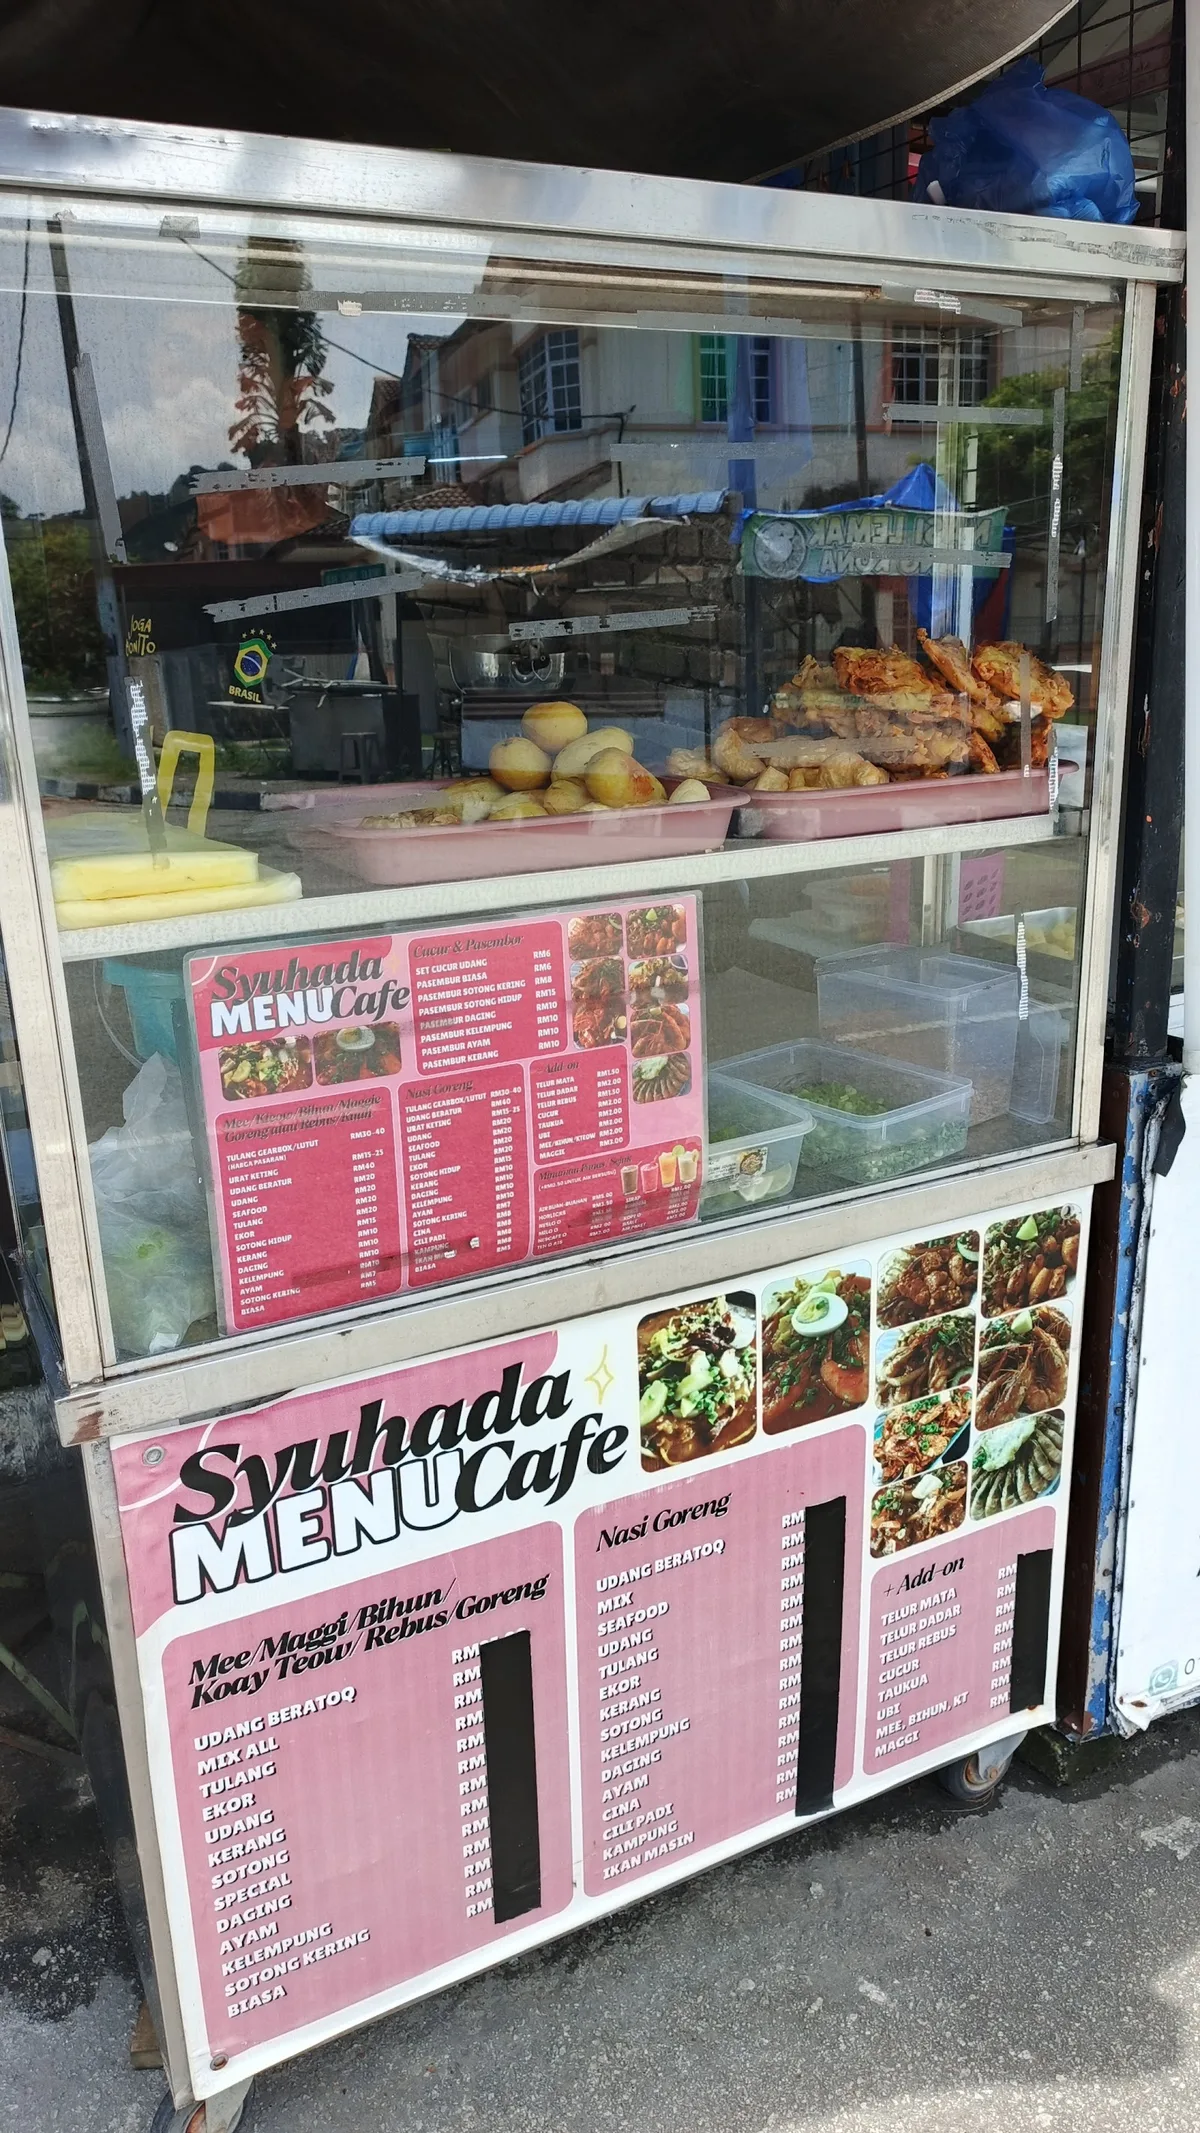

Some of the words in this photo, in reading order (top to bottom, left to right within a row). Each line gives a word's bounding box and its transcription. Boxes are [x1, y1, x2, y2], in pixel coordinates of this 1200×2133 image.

[128, 615, 152, 639] JOGA
[228, 684, 262, 704] BRASIL
[413, 943, 450, 959] Cucur
[452, 940, 463, 953] &
[415, 966, 429, 975] SET
[430, 962, 458, 973] CUCUR
[458, 958, 487, 969] UDANG
[532, 949, 550, 959] RM6
[211, 951, 384, 1005] Syuhada
[416, 975, 460, 988] PASEMBUR
[461, 971, 487, 982] BIASA
[533, 962, 551, 972] RM6
[417, 988, 461, 1002] PASEMBUR
[462, 984, 495, 995] SOTONG
[496, 979, 525, 990] KERING
[534, 975, 552, 984] RM8
[210, 986, 335, 1038] MENU
[331, 979, 411, 1022] Cafe
[418, 1002, 462, 1016] PASEMBUR
[463, 997, 496, 1009] SOTONG
[497, 993, 522, 1004] HIDUP
[535, 988, 556, 998] RM15
[464, 1010, 496, 1022] DAGING
[536, 1000, 557, 1011] RM10
[420, 1029, 464, 1043] PASEMBUR
[465, 1021, 512, 1035] KELEMPUNG
[536, 1013, 558, 1024] RM10
[421, 1042, 465, 1056] PASEMBUR
[466, 1038, 490, 1048] AYAM
[537, 1026, 559, 1037] RM10
[422, 1055, 466, 1069] PASEMBUR
[467, 1049, 498, 1062] KERANG
[538, 1039, 559, 1049] RM10
[226, 1150, 256, 1162] TULANG
[257, 1139, 318, 1156] GEARBOX/LUTUT
[408, 1140, 440, 1152] SEAFOOD
[228, 1173, 249, 1184] URAT
[250, 1168, 278, 1179] KETING
[229, 1184, 257, 1195] UDANG
[257, 1177, 292, 1190] BERATUR
[352, 1161, 375, 1171] RM40
[230, 1195, 258, 1207] UDANG
[353, 1172, 375, 1183] RM20
[410, 1179, 438, 1190] KERANG
[232, 1205, 267, 1218] SEAFOOD
[354, 1183, 376, 1194] RM20
[233, 1217, 263, 1229] TULANG
[355, 1194, 376, 1204] RM20
[411, 1194, 452, 1209] KELEMPUNG
[234, 1230, 254, 1240] EKOR
[356, 1205, 377, 1215] RM20
[235, 1239, 267, 1251] SOTONG
[267, 1234, 292, 1245] HIDUP
[356, 1216, 376, 1226] RM15
[236, 1250, 267, 1263] KERANG
[357, 1227, 378, 1237] RM10
[237, 1261, 268, 1274] DAGING
[358, 1237, 378, 1247] RM10
[238, 1269, 284, 1285] KELEMPUNG
[358, 1248, 379, 1258] RM10
[239, 1284, 262, 1295] AYAM
[240, 1293, 271, 1305] SOTONG
[272, 1287, 300, 1298] KERING
[240, 1304, 264, 1315] BIASA
[171, 1362, 573, 1528] Syuhada
[169, 1448, 466, 1606] MENU
[454, 1412, 629, 1514] Cafe
[596, 1514, 648, 1552] Nasi
[652, 1493, 732, 1531] Goreng
[596, 1563, 650, 1591] UDANG
[654, 1538, 723, 1572] BERATOQ
[896, 1557, 965, 1596] Add-on
[597, 1591, 631, 1614] MIX
[597, 1601, 667, 1636] SEAFOOD
[880, 1602, 916, 1625] TELUR
[919, 1587, 955, 1610] MATA
[879, 1621, 916, 1645] TELUR
[918, 1603, 960, 1630] DADAR
[597, 1628, 651, 1656] UDANG
[879, 1641, 915, 1664] TELUR
[918, 1624, 955, 1649] REBUS
[598, 1647, 656, 1678] TULANG
[878, 1658, 918, 1683] CUCUR
[189, 1670, 270, 1710] Koay
[599, 1675, 639, 1700] EKOR
[599, 1687, 659, 1721] KERANG
[877, 1673, 927, 1702] TAUKUA
[193, 1716, 262, 1750] UDANG
[267, 1686, 354, 1726] BERATOQ
[600, 1708, 661, 1741] SOTONG
[875, 1719, 905, 1739] MEE,
[908, 1700, 950, 1725] BIHUN,
[953, 1690, 968, 1706] KT
[876, 1702, 899, 1720] UBI
[197, 1748, 240, 1775] MIX
[245, 1736, 277, 1758] ALL
[600, 1717, 688, 1762] KELEMPUNG
[874, 1730, 918, 1757] MAGGI
[198, 1760, 273, 1797] TULANG
[601, 1748, 659, 1782] DAGING
[601, 1773, 647, 1802] AYAM
[202, 1792, 253, 1821] EKOR
[601, 1797, 638, 1821] CINA
[602, 1818, 633, 1840] CILI
[635, 1802, 671, 1827] PADI
[204, 1809, 271, 1843] UDANG
[602, 1819, 676, 1860] KAMPUNG
[207, 1827, 283, 1867] KERANG
[602, 1853, 640, 1879] IKAN
[644, 1831, 692, 1861] MASIN
[211, 1849, 287, 1889] SOTONG
[213, 1872, 289, 1911] SPECIAL
[216, 1894, 289, 1933] DAGING
[219, 1921, 276, 1955] AYAM
[221, 1922, 330, 1976] KELEMPUNG
[224, 1956, 298, 1996] SOTONG
[302, 1928, 368, 1965] KERING
[227, 1984, 284, 2017] BIASA
